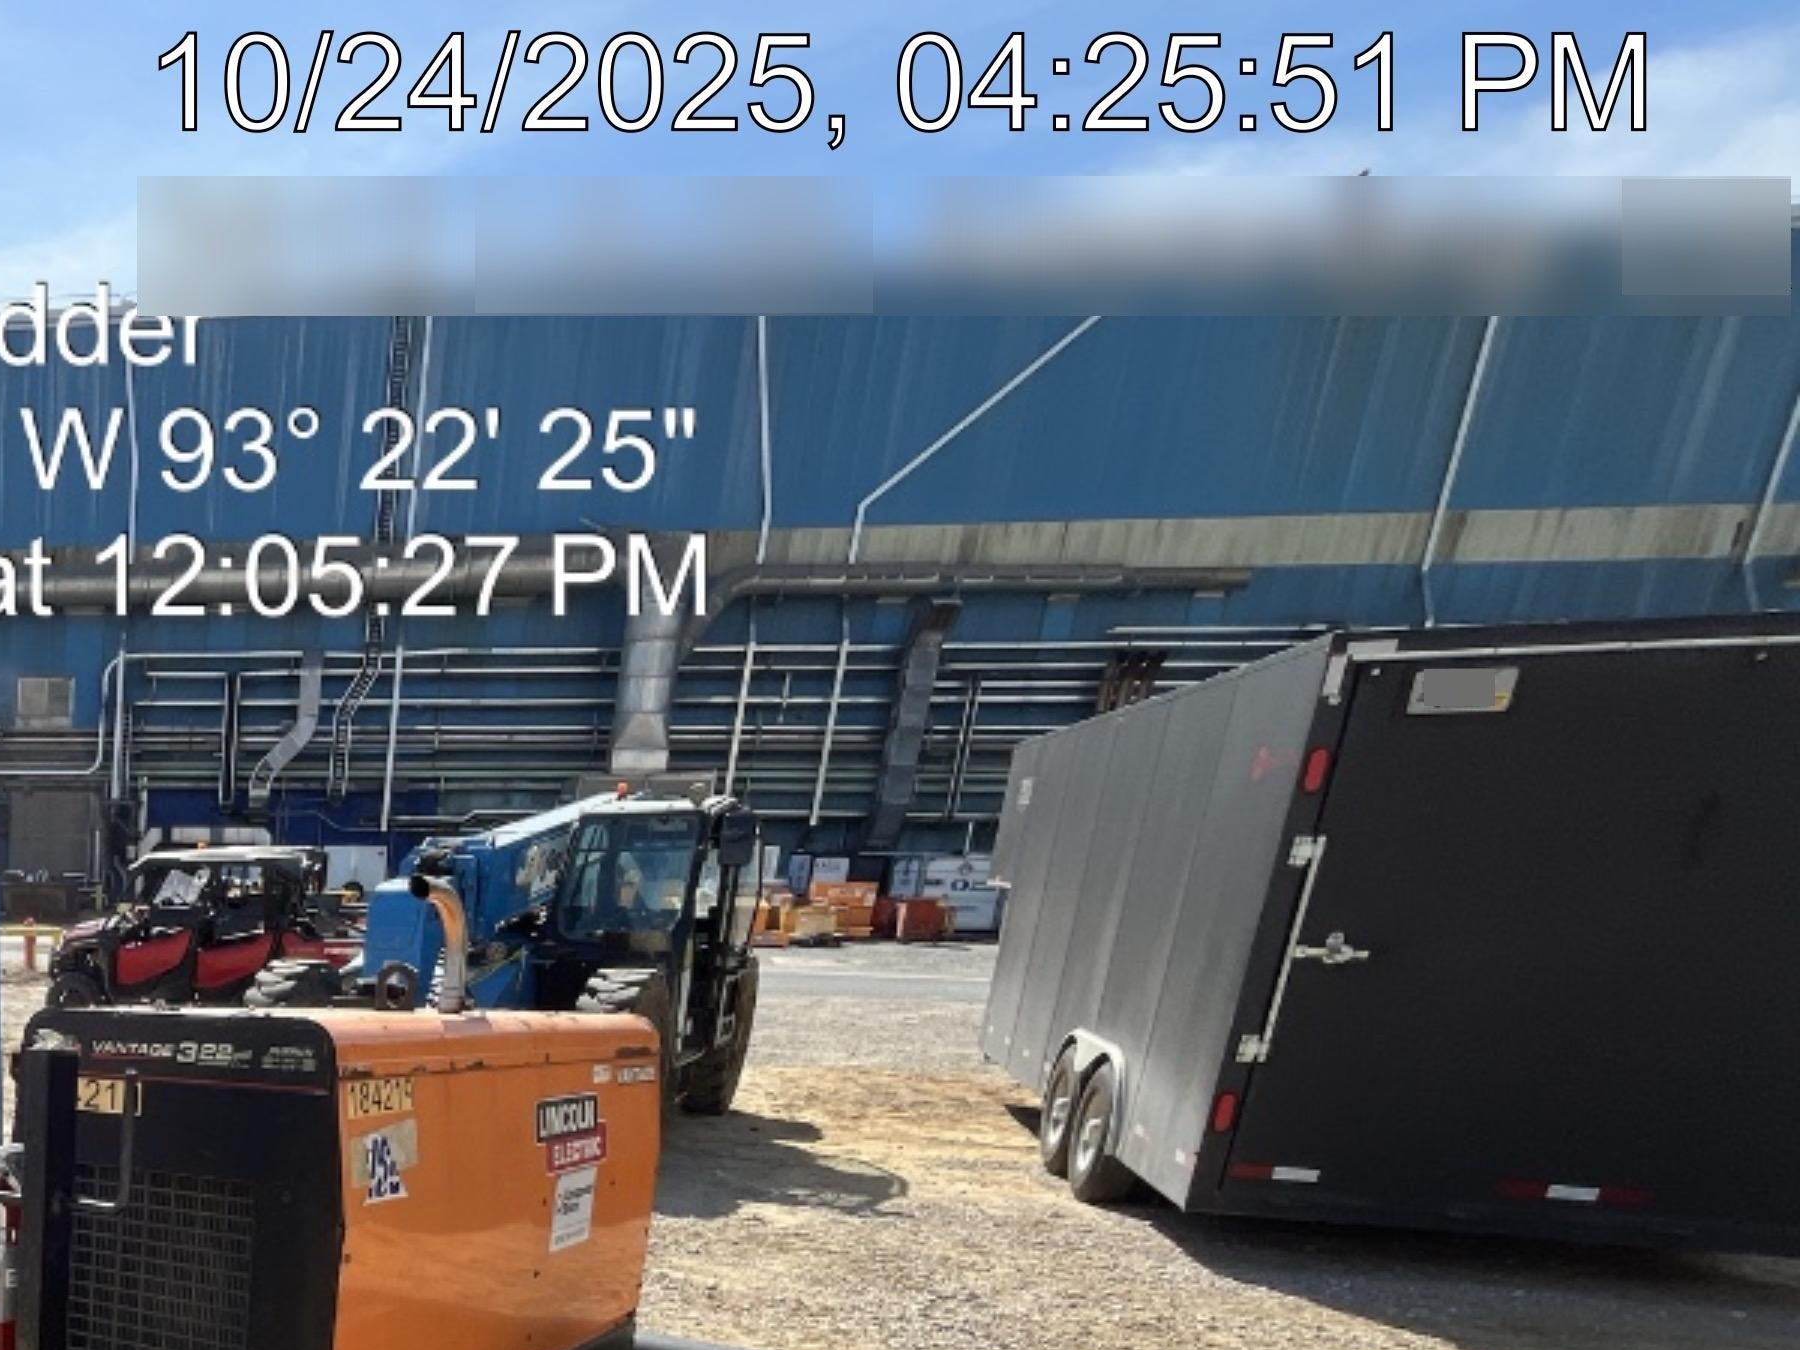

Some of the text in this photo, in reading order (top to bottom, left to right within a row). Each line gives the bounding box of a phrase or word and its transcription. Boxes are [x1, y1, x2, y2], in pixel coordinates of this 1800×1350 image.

[92, 1040, 173, 1058] VANTAGE
[539, 1100, 595, 1138] LINCOLN
[553, 1136, 601, 1167] ELECTRIC
